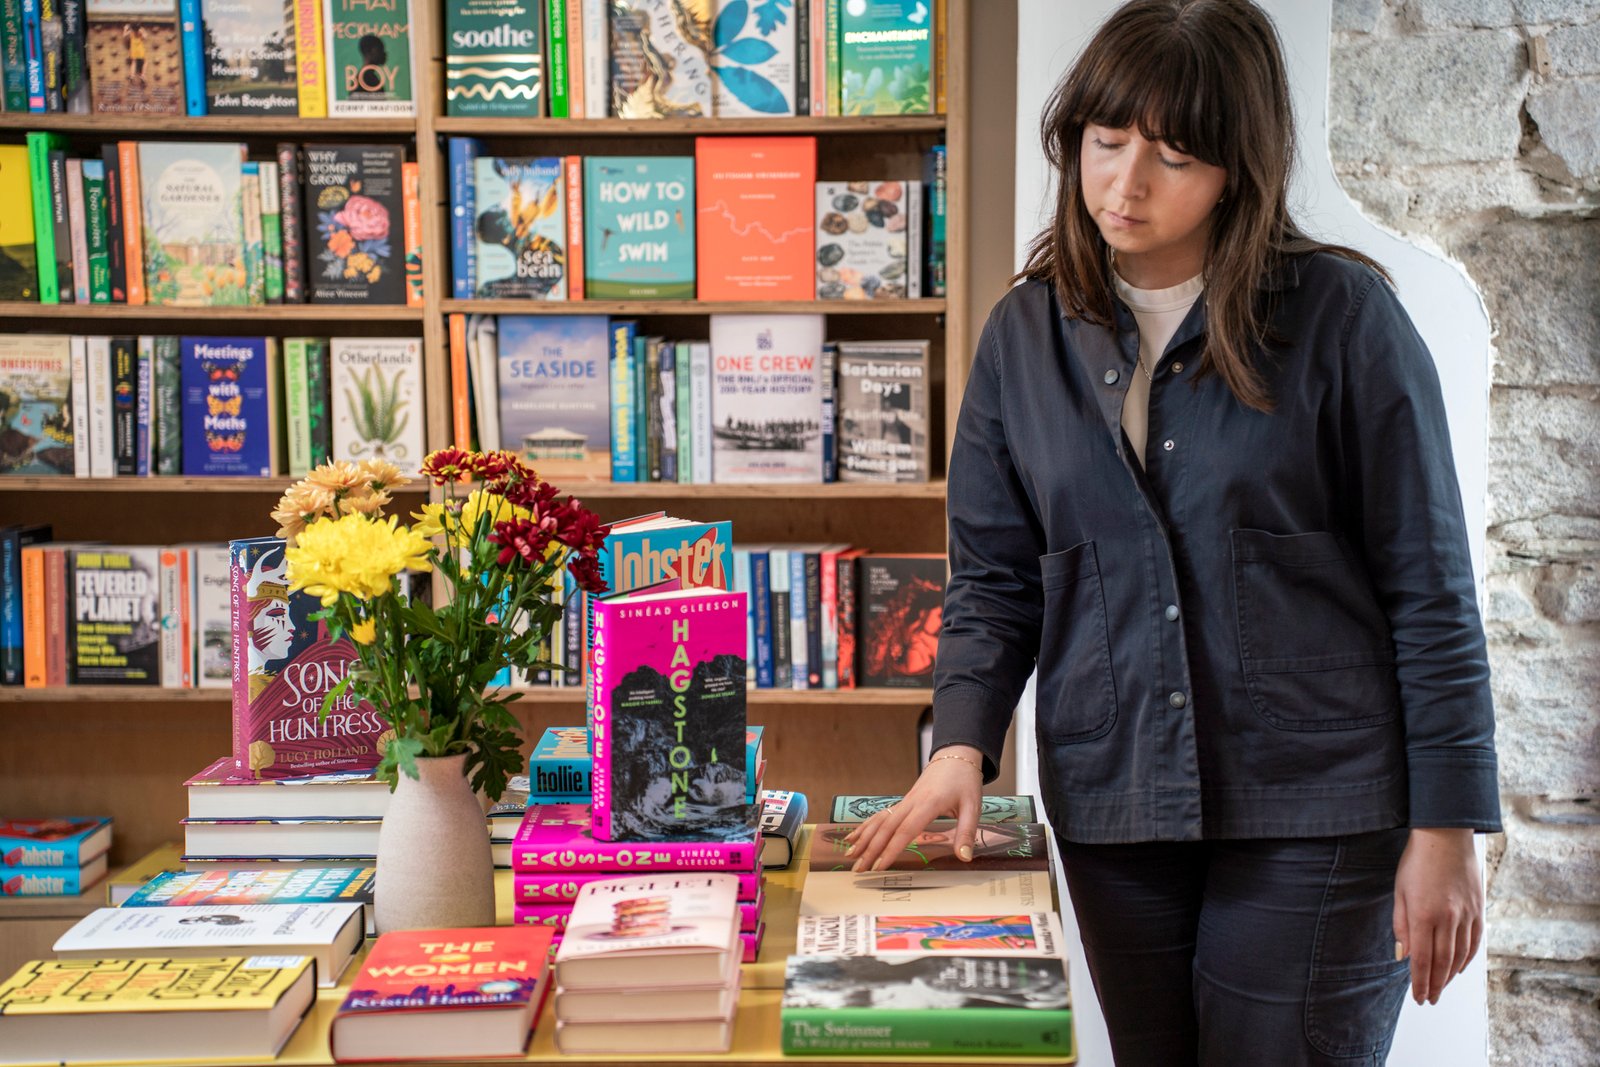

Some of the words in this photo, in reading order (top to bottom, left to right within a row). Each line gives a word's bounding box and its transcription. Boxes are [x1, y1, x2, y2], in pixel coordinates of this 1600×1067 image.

[452, 23, 535, 48] soothe
[345, 64, 399, 91] BOY
[214, 95, 239, 107] John
[308, 151, 338, 162] WHY
[309, 162, 357, 174] WOMEN
[310, 174, 347, 185] GROW
[600, 182, 651, 203] HOW
[656, 182, 684, 200] TO
[616, 210, 670, 233] WILD
[523, 250, 553, 263] sea
[619, 242, 668, 262] SWIM
[517, 258, 561, 278] bean
[194, 344, 254, 361] Meetings
[339, 351, 412, 364] Otherlands
[543, 347, 562, 356] THE
[510, 361, 596, 378] SEASIDE
[716, 356, 753, 372] ONE
[760, 356, 815, 372] CREW
[841, 361, 922, 377] Barbarian
[209, 382, 240, 396] with
[861, 378, 901, 396] Days
[204, 415, 247, 430] Moths
[851, 439, 911, 454] William
[846, 455, 917, 473] Finnegan
[614, 538, 725, 593] lobster
[76, 570, 146, 594] FEVERED
[231, 565, 240, 592] SONG
[77, 596, 140, 621] PLANET
[232, 594, 239, 607] OF
[620, 606, 672, 618] SINÉAD
[680, 600, 739, 613] GLEESON
[233, 634, 241, 683] HUNTRESS
[594, 611, 606, 758] HAGSTONE
[302, 697, 321, 713] OF
[329, 695, 357, 711] HE
[269, 711, 382, 742] HUNTRESS
[669, 619, 691, 818] HAGSTONE
[280, 752, 310, 763] LUCY
[314, 745, 369, 760] HOLLAND
[537, 765, 582, 792] hollie
[20, 845, 64, 866] lobster
[522, 850, 671, 867] HAGSTONE
[677, 857, 725, 866] GLEESON
[680, 849, 720, 858] SINÉAD
[20, 874, 64, 894] lobster
[419, 941, 495, 954] THE
[367, 961, 528, 978] WOMEN
[791, 1021, 822, 1037] The
[824, 1021, 892, 1037] Swimmer
